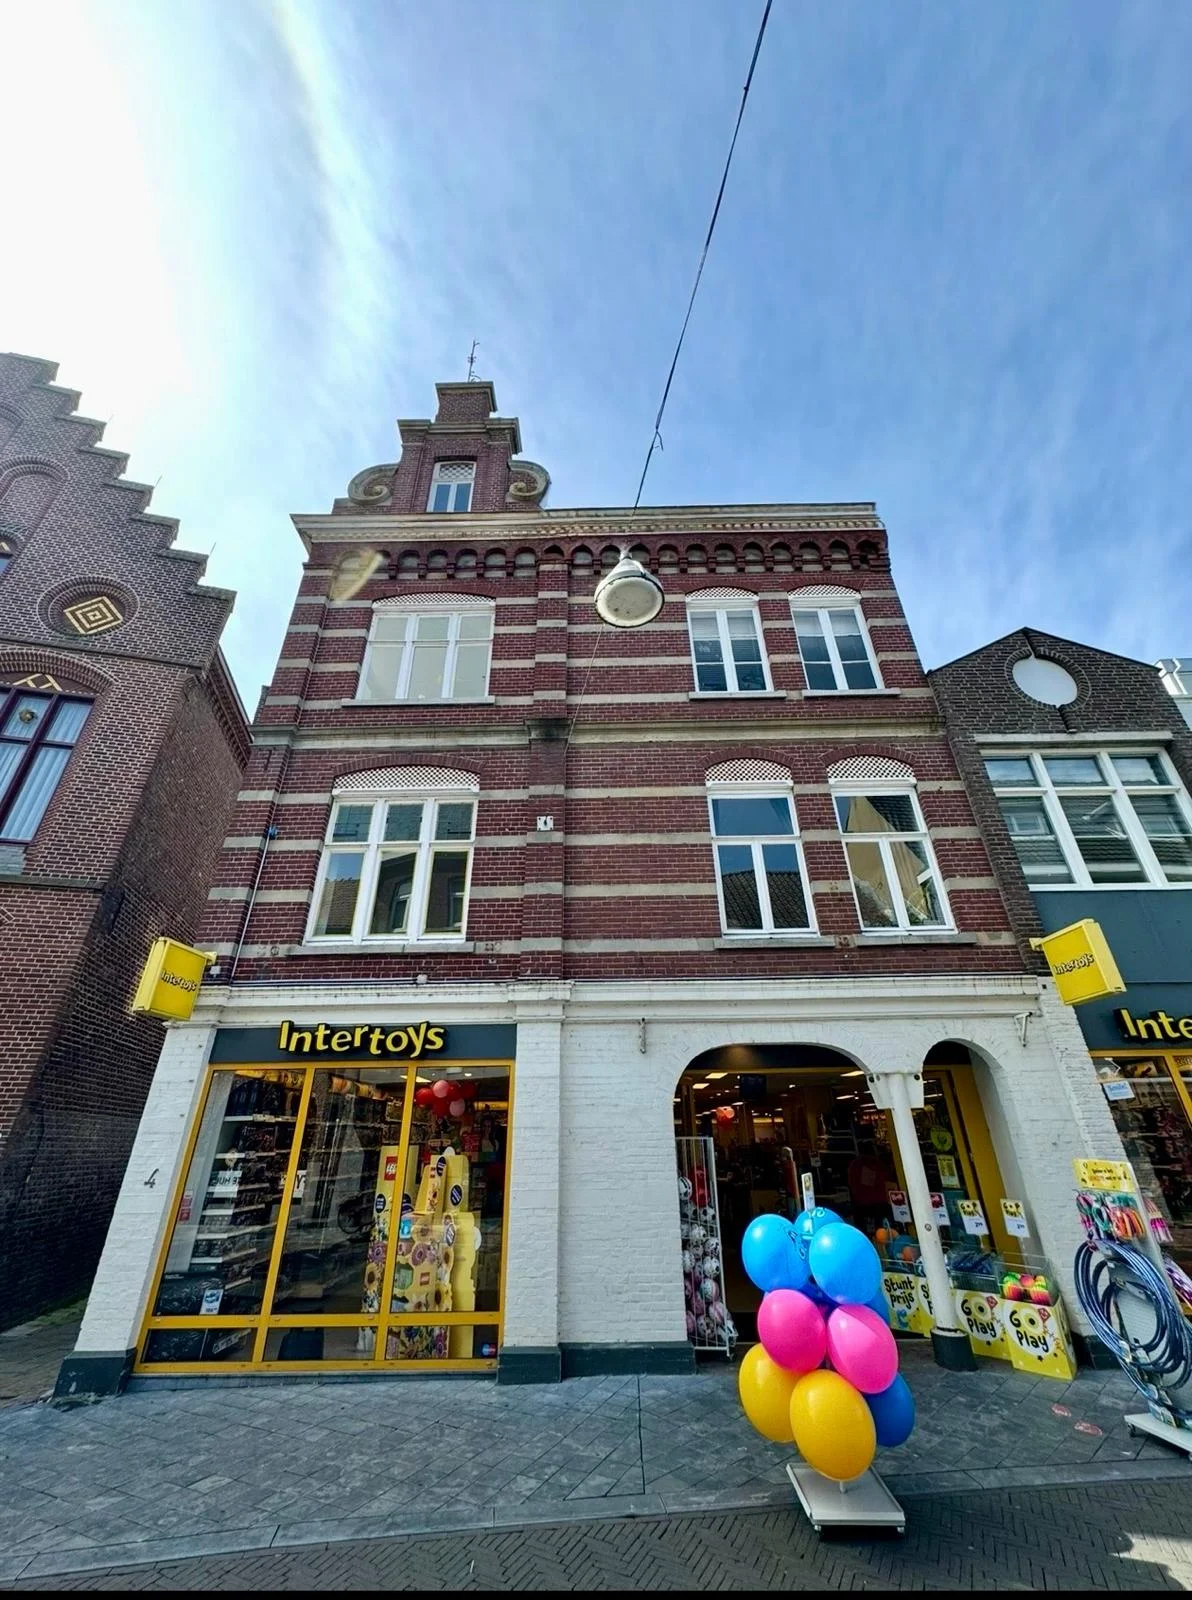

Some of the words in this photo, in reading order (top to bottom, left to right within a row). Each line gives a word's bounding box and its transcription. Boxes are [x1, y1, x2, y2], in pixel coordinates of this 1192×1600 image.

[1052, 952, 1095, 976] Intertoys
[161, 970, 198, 992] Intertoys
[279, 1020, 446, 1059] Intertoys
[143, 1168, 159, 1189] 4
[884, 1276, 915, 1293] Stunt
[967, 1317, 997, 1338] Play
[1016, 1330, 1050, 1353] Play
